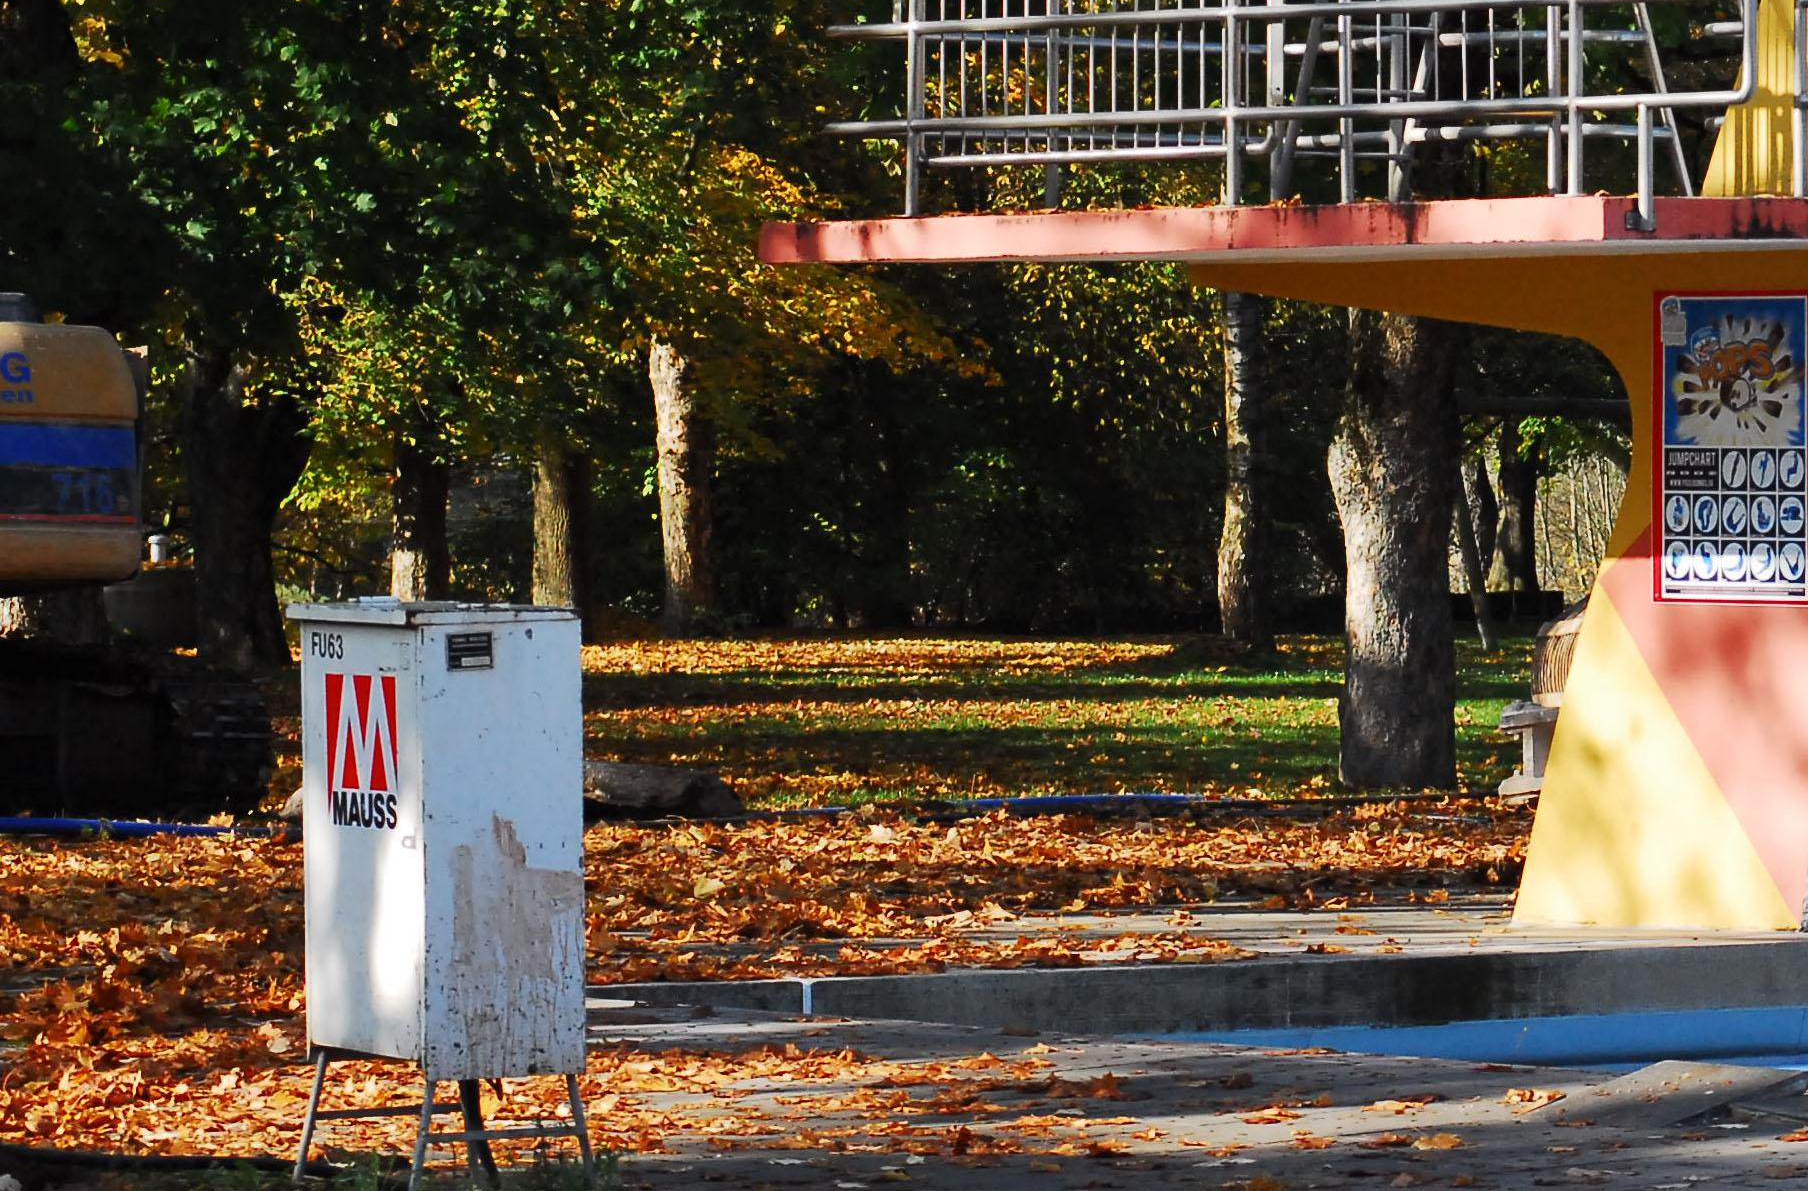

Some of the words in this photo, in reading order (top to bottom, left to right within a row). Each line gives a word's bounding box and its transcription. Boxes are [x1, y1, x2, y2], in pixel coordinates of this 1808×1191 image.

[1668, 451, 1716, 466] JUMPCHART
[311, 631, 344, 659] FU63
[332, 790, 398, 830] MAUSS
